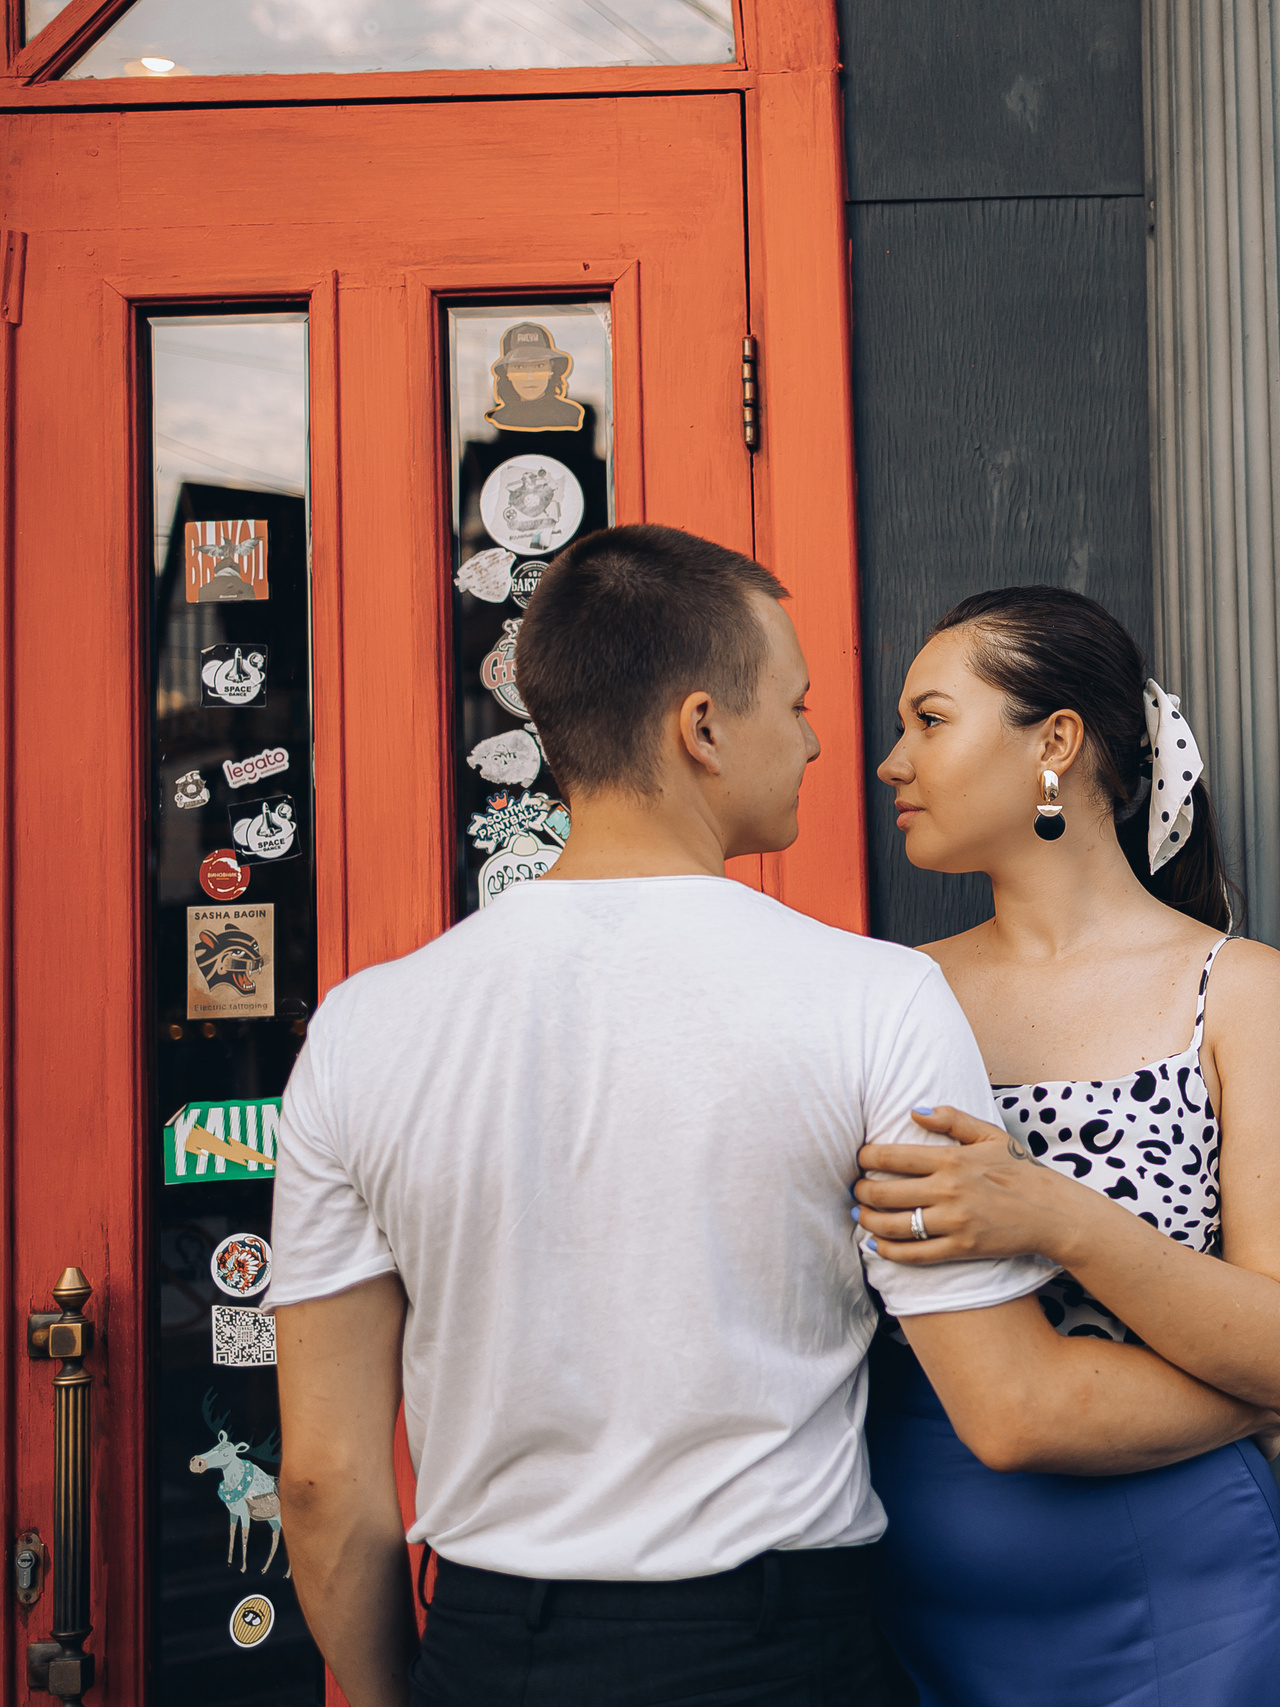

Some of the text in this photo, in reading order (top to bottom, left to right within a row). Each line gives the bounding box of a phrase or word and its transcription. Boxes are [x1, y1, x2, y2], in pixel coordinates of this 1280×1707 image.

[224, 685, 251, 693] SPACE
[226, 751, 285, 780] legato
[478, 805, 538, 839] PAINTBALL
[486, 802, 523, 826] SOUTH
[491, 820, 529, 843] FAMILY
[257, 838, 286, 849] SPACE
[194, 909, 267, 921] SASHA BAGIN
[193, 1003, 227, 1012] Electric
